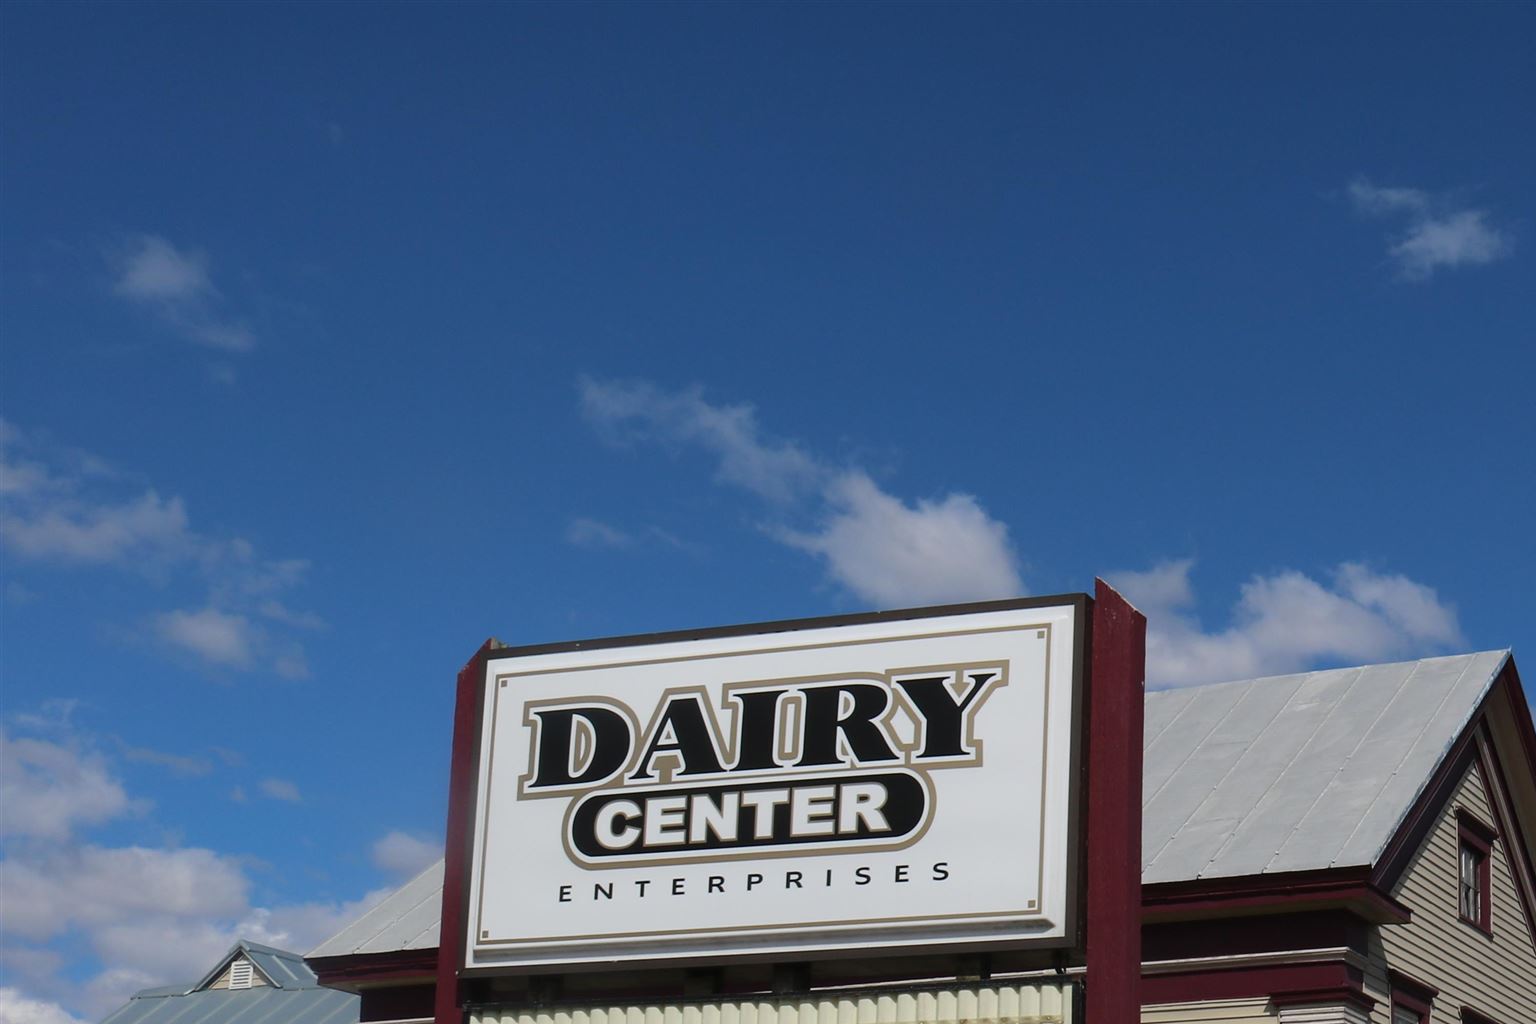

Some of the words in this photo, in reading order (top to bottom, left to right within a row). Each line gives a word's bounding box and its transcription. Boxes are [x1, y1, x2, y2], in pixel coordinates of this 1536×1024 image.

[524, 669, 1000, 791] DAIRY
[594, 781, 892, 850] CENTER
[558, 861, 950, 903] ENTERPRISES
